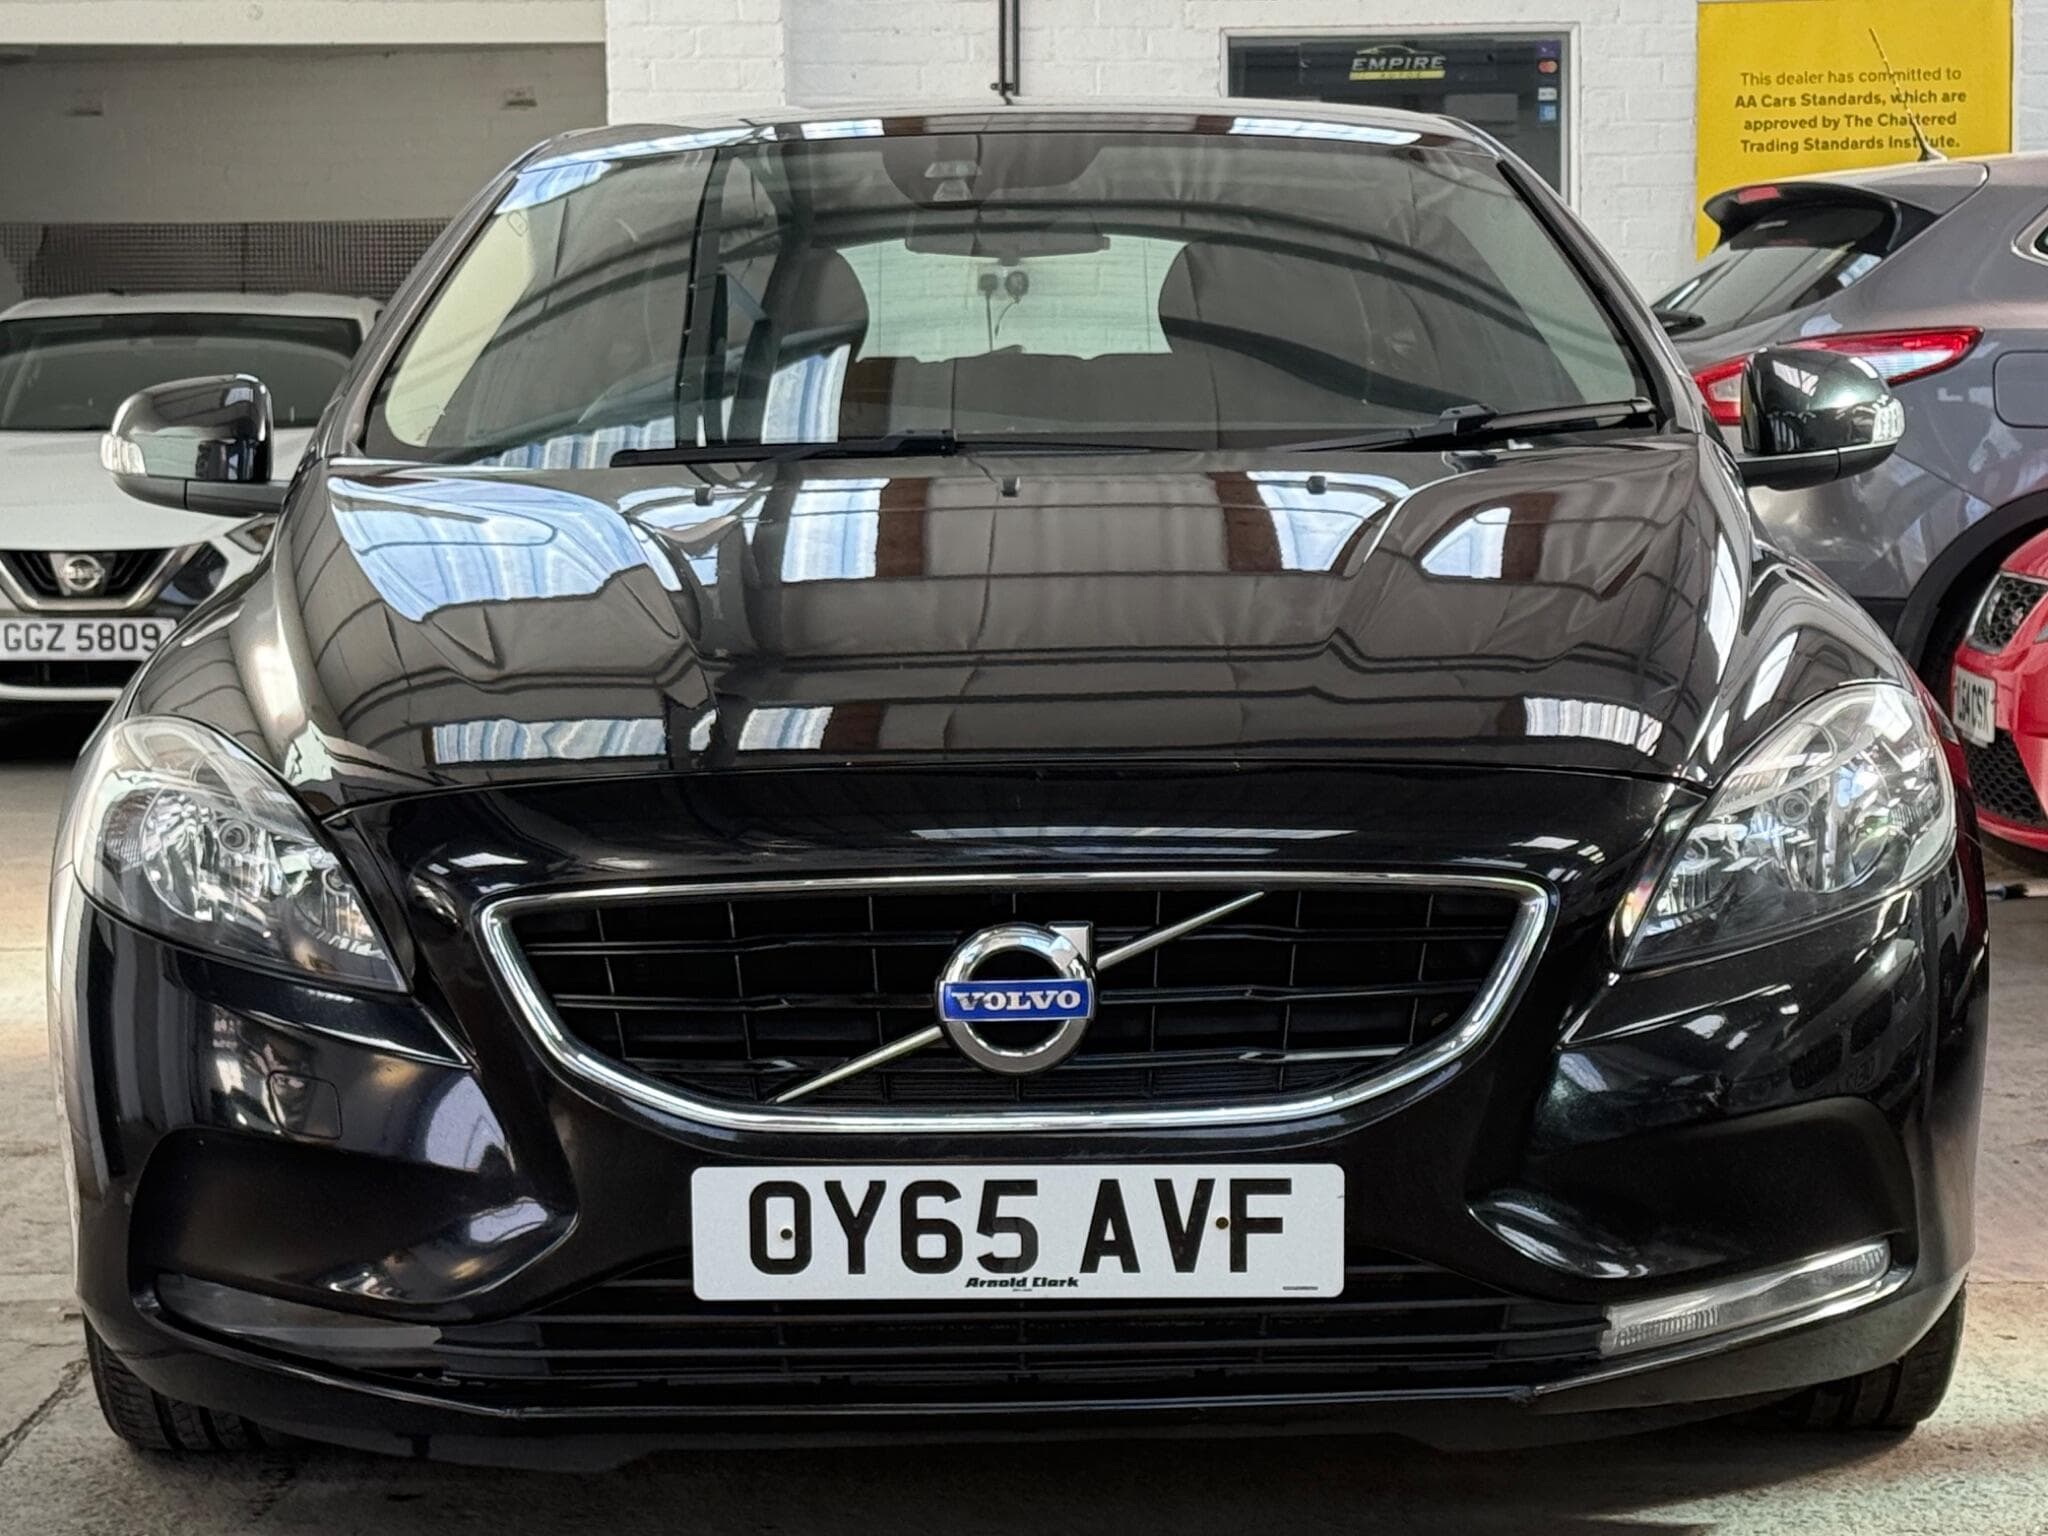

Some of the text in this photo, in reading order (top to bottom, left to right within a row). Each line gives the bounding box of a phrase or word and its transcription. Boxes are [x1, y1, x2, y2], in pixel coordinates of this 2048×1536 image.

[1352, 56, 1446, 71] EMPIRE
[1741, 67, 1962, 86] This dealer has committed to
[1735, 89, 1966, 108] AA Cars Standards, which are
[1744, 111, 1957, 132] approved by The Chatered
[1741, 134, 1960, 154] Trading Standards Instute.
[4, 623, 162, 652] GGZ 5809
[951, 990, 1081, 1011] VOLVO
[749, 1178, 1293, 1275] OY65 AVF
[965, 1276, 1079, 1288] Arnold Clark
